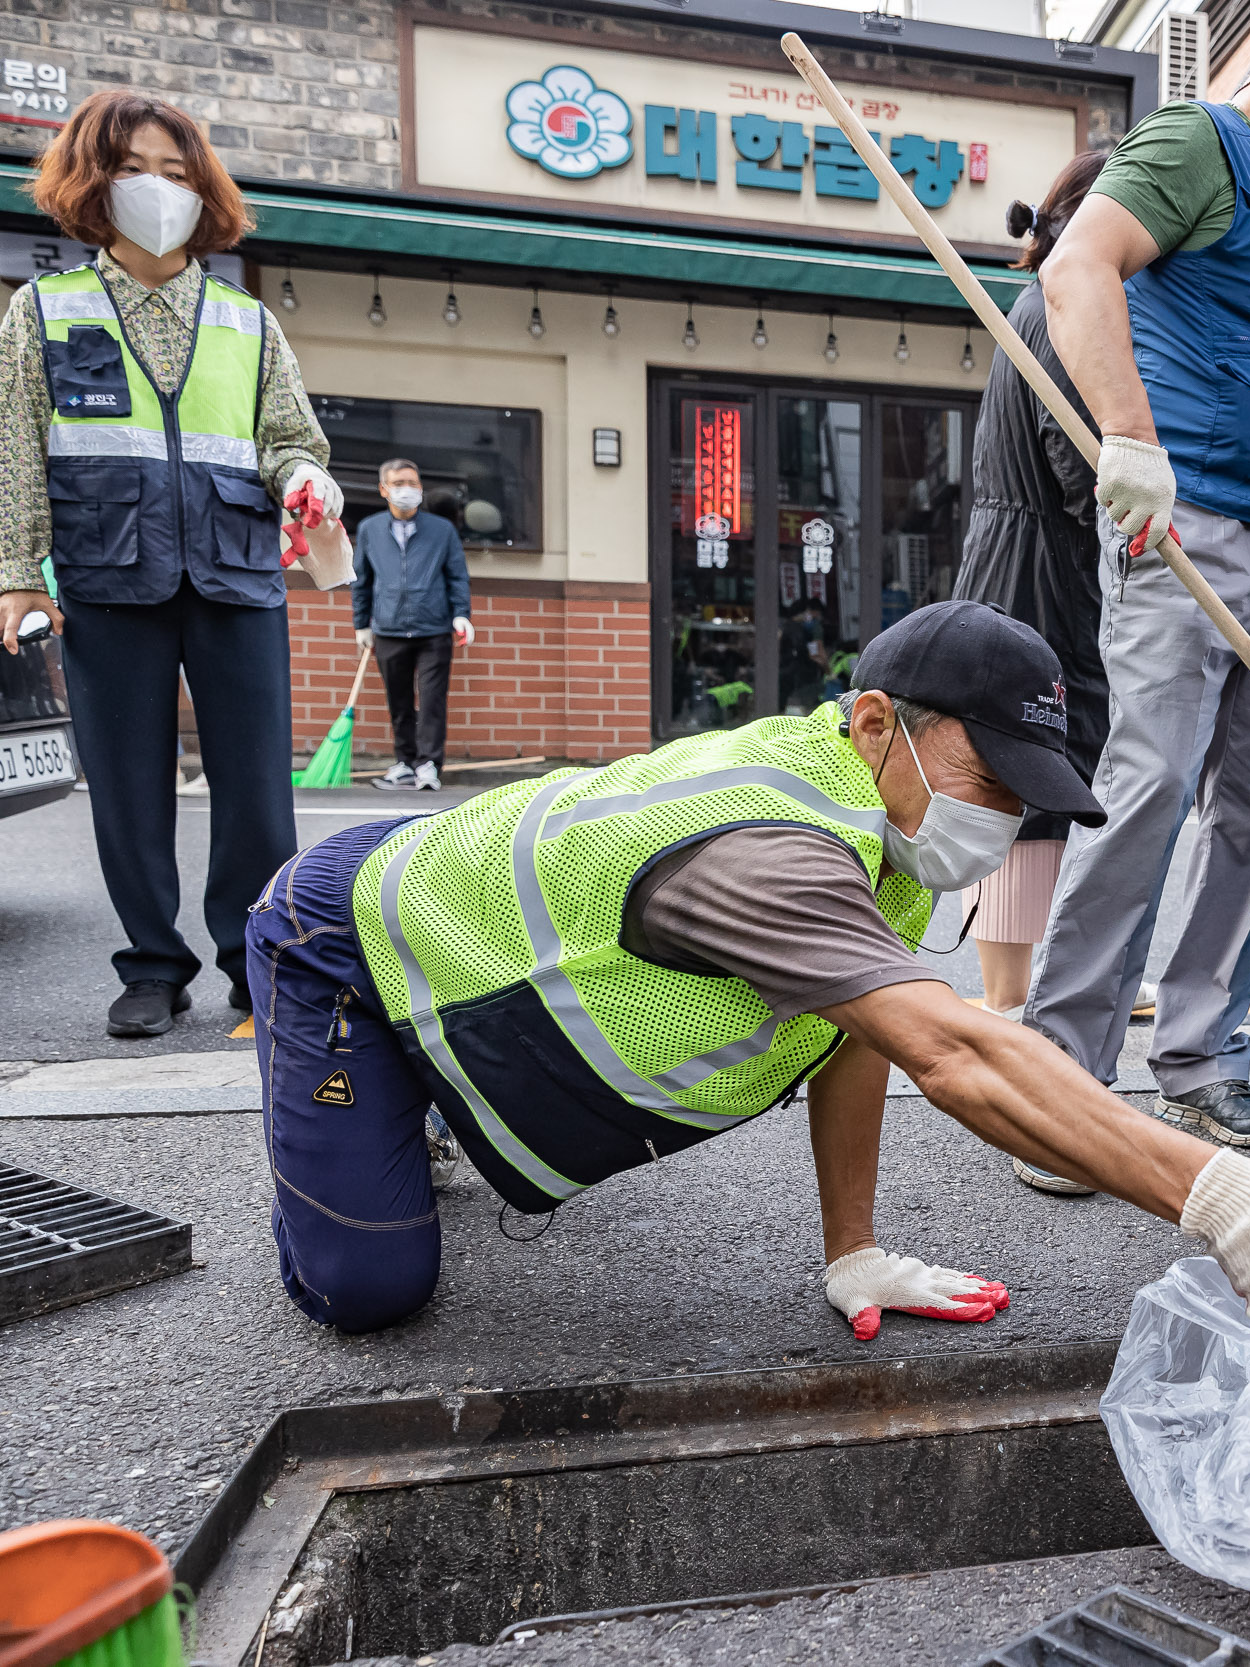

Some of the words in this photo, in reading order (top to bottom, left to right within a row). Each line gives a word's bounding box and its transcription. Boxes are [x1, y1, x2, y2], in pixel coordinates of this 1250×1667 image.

[5, 58, 66, 95] 문의
[728, 82, 789, 105] 그녀가
[862, 98, 902, 121] 곱창
[643, 103, 965, 208] 대한곱창
[1037, 694, 1055, 704] TRADE
[21, 739, 64, 778] 5658
[322, 1090, 346, 1101] SPRING
